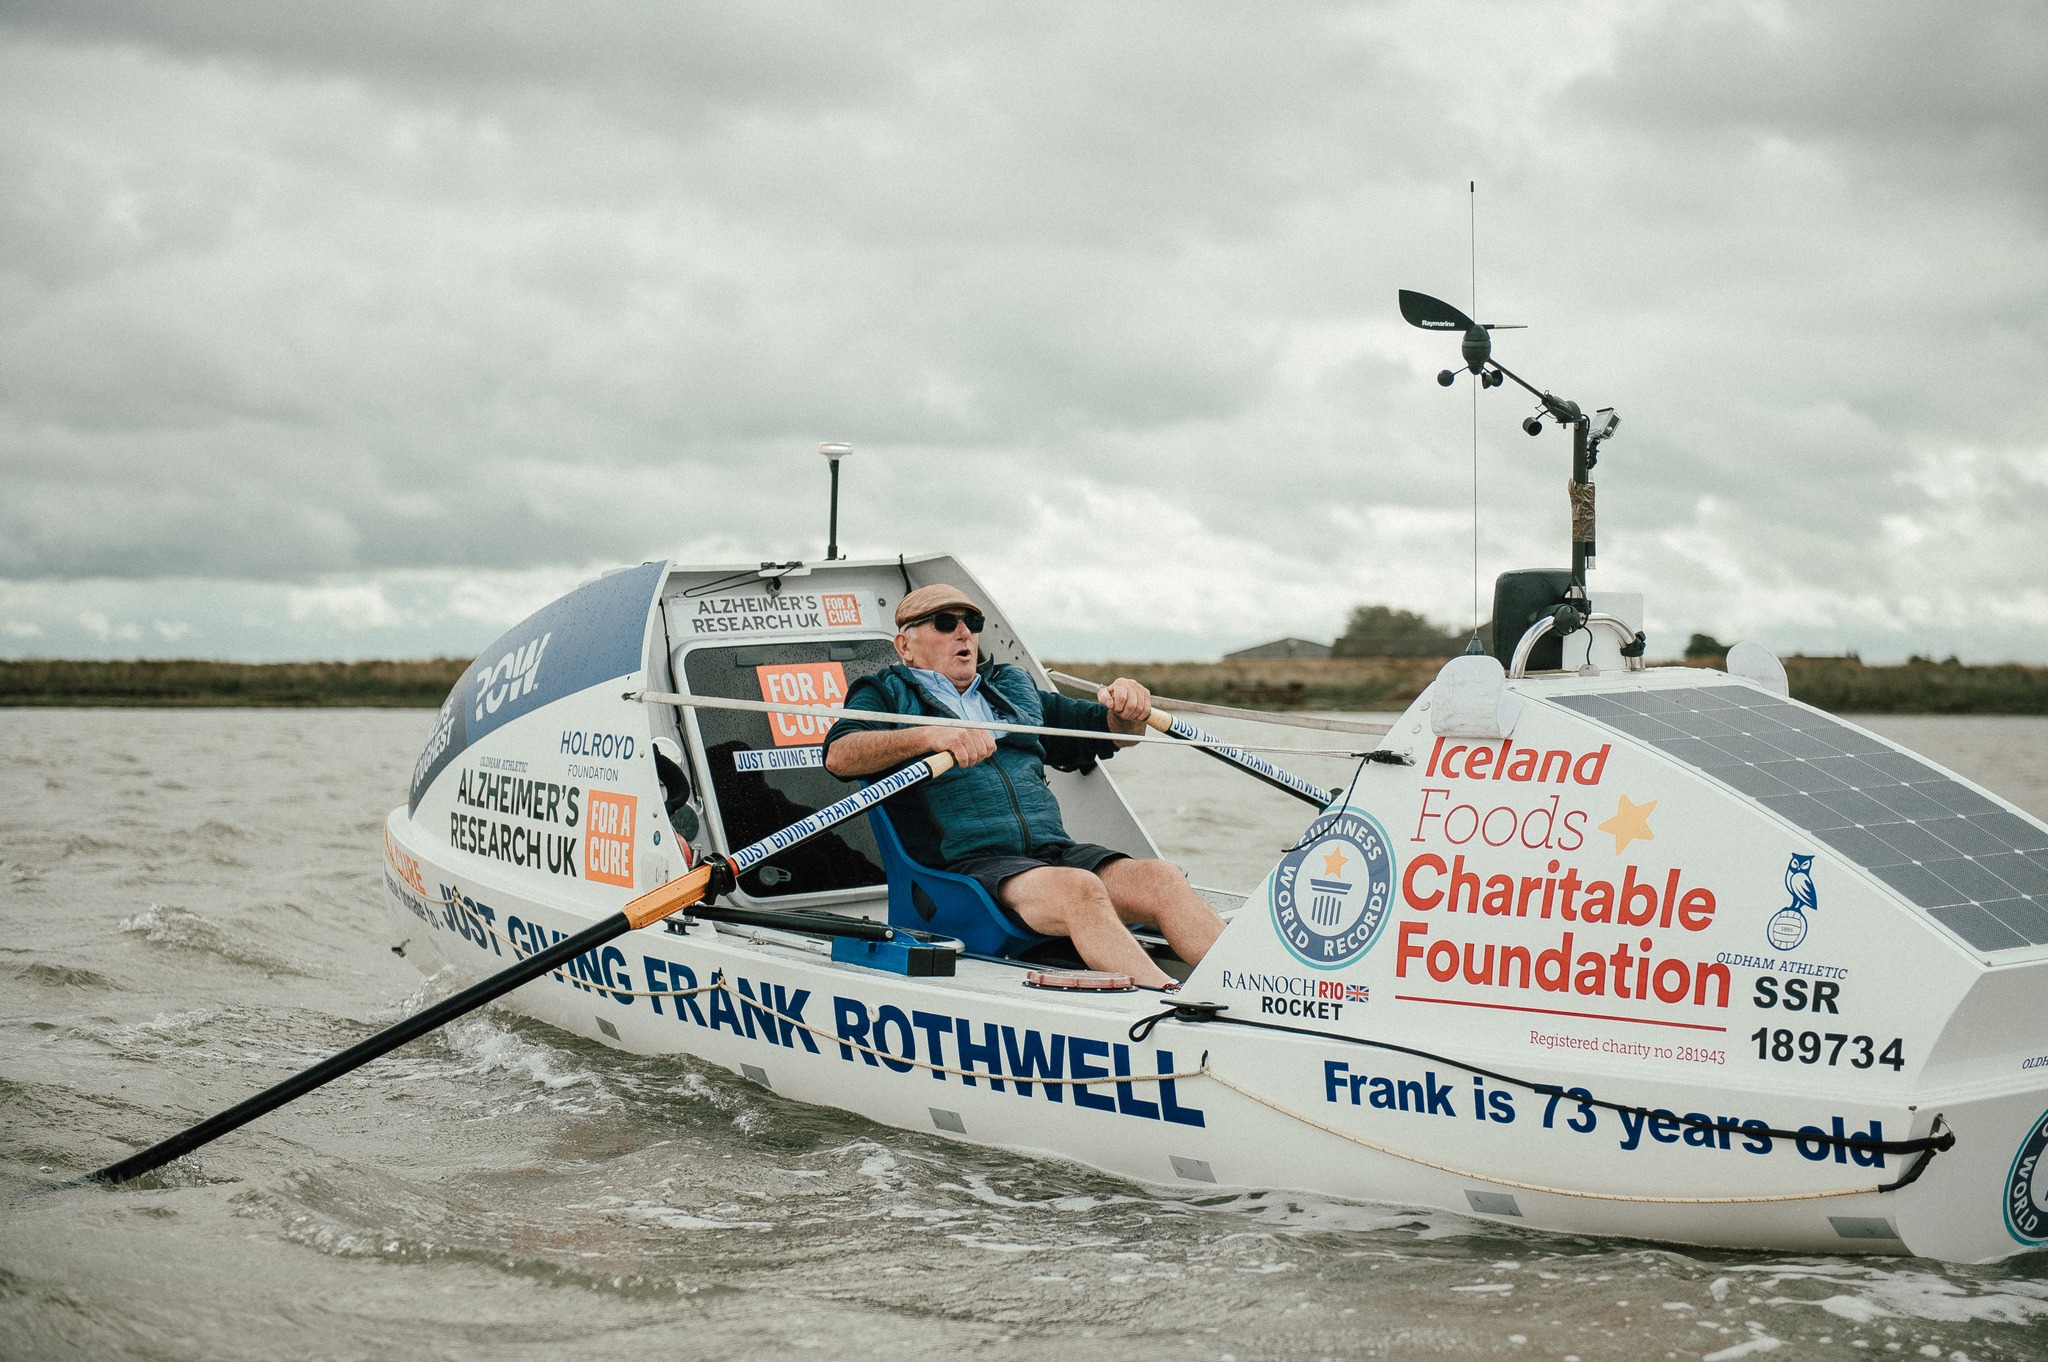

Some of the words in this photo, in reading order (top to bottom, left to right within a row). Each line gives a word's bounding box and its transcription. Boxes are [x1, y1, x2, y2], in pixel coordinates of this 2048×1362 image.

[1421, 319, 1455, 328] Raymarine
[698, 595, 817, 615] ALZHEIMER'S
[825, 597, 846, 610] FOR
[847, 595, 855, 608] A
[828, 609, 858, 624] CURE
[692, 614, 793, 633] RESEARCH
[796, 613, 822, 628] UK
[767, 672, 818, 702] FOR
[822, 671, 842, 700] A
[479, 756, 501, 769] OLDHAM
[502, 758, 528, 773] ATHLETIC
[560, 730, 635, 760] HOLROYD
[737, 752, 764, 770] JUST
[768, 750, 807, 767] GIVING
[1173, 718, 1199, 743] JUST
[1240, 751, 1274, 776] FRANK
[1277, 768, 1331, 803] ROTHWELL
[1424, 736, 1612, 786] Iceland
[568, 764, 619, 782] FOUNDATION
[457, 768, 581, 828] ALZHEIMER'S
[738, 840, 770, 868] JUST
[771, 817, 817, 849] GIVING
[816, 796, 861, 827] FRANK
[860, 763, 929, 804] ROTHWELL
[591, 800, 619, 835] FOR
[620, 805, 631, 838] A
[1410, 788, 1588, 851] Foods
[450, 812, 541, 870] RESEARCH
[546, 833, 577, 878] UK
[589, 836, 630, 877] CURE
[1299, 819, 1382, 861] GUINNESS
[1278, 865, 1309, 949] WORLD
[1323, 881, 1386, 957] RECORDS
[1402, 852, 1716, 932] Charitable
[1222, 970, 1316, 997] RANNOCH
[1395, 920, 1731, 1008] Foundation
[1716, 952, 1776, 970] OLDHAM
[1778, 960, 1848, 979] ATHLETIC
[439, 883, 502, 957] JUST
[642, 954, 821, 1055] FRANK
[833, 995, 1206, 1128] ROTHWELL
[1261, 996, 1343, 1021] ROCKET
[1753, 976, 1840, 1015] SSR
[1529, 1030, 1599, 1051] Registered
[1602, 1034, 1650, 1059] charity
[1654, 1047, 1673, 1059] no
[1676, 1046, 1726, 1065] 281943
[1751, 1027, 1905, 1072] 189734
[1323, 1061, 1457, 1118] Frank
[1473, 1076, 1516, 1124] is
[1532, 1084, 1597, 1134] 73
[1617, 1106, 1773, 1155] years
[1795, 1115, 1886, 1169] old
[2013, 1155, 2039, 1232] WORLD
